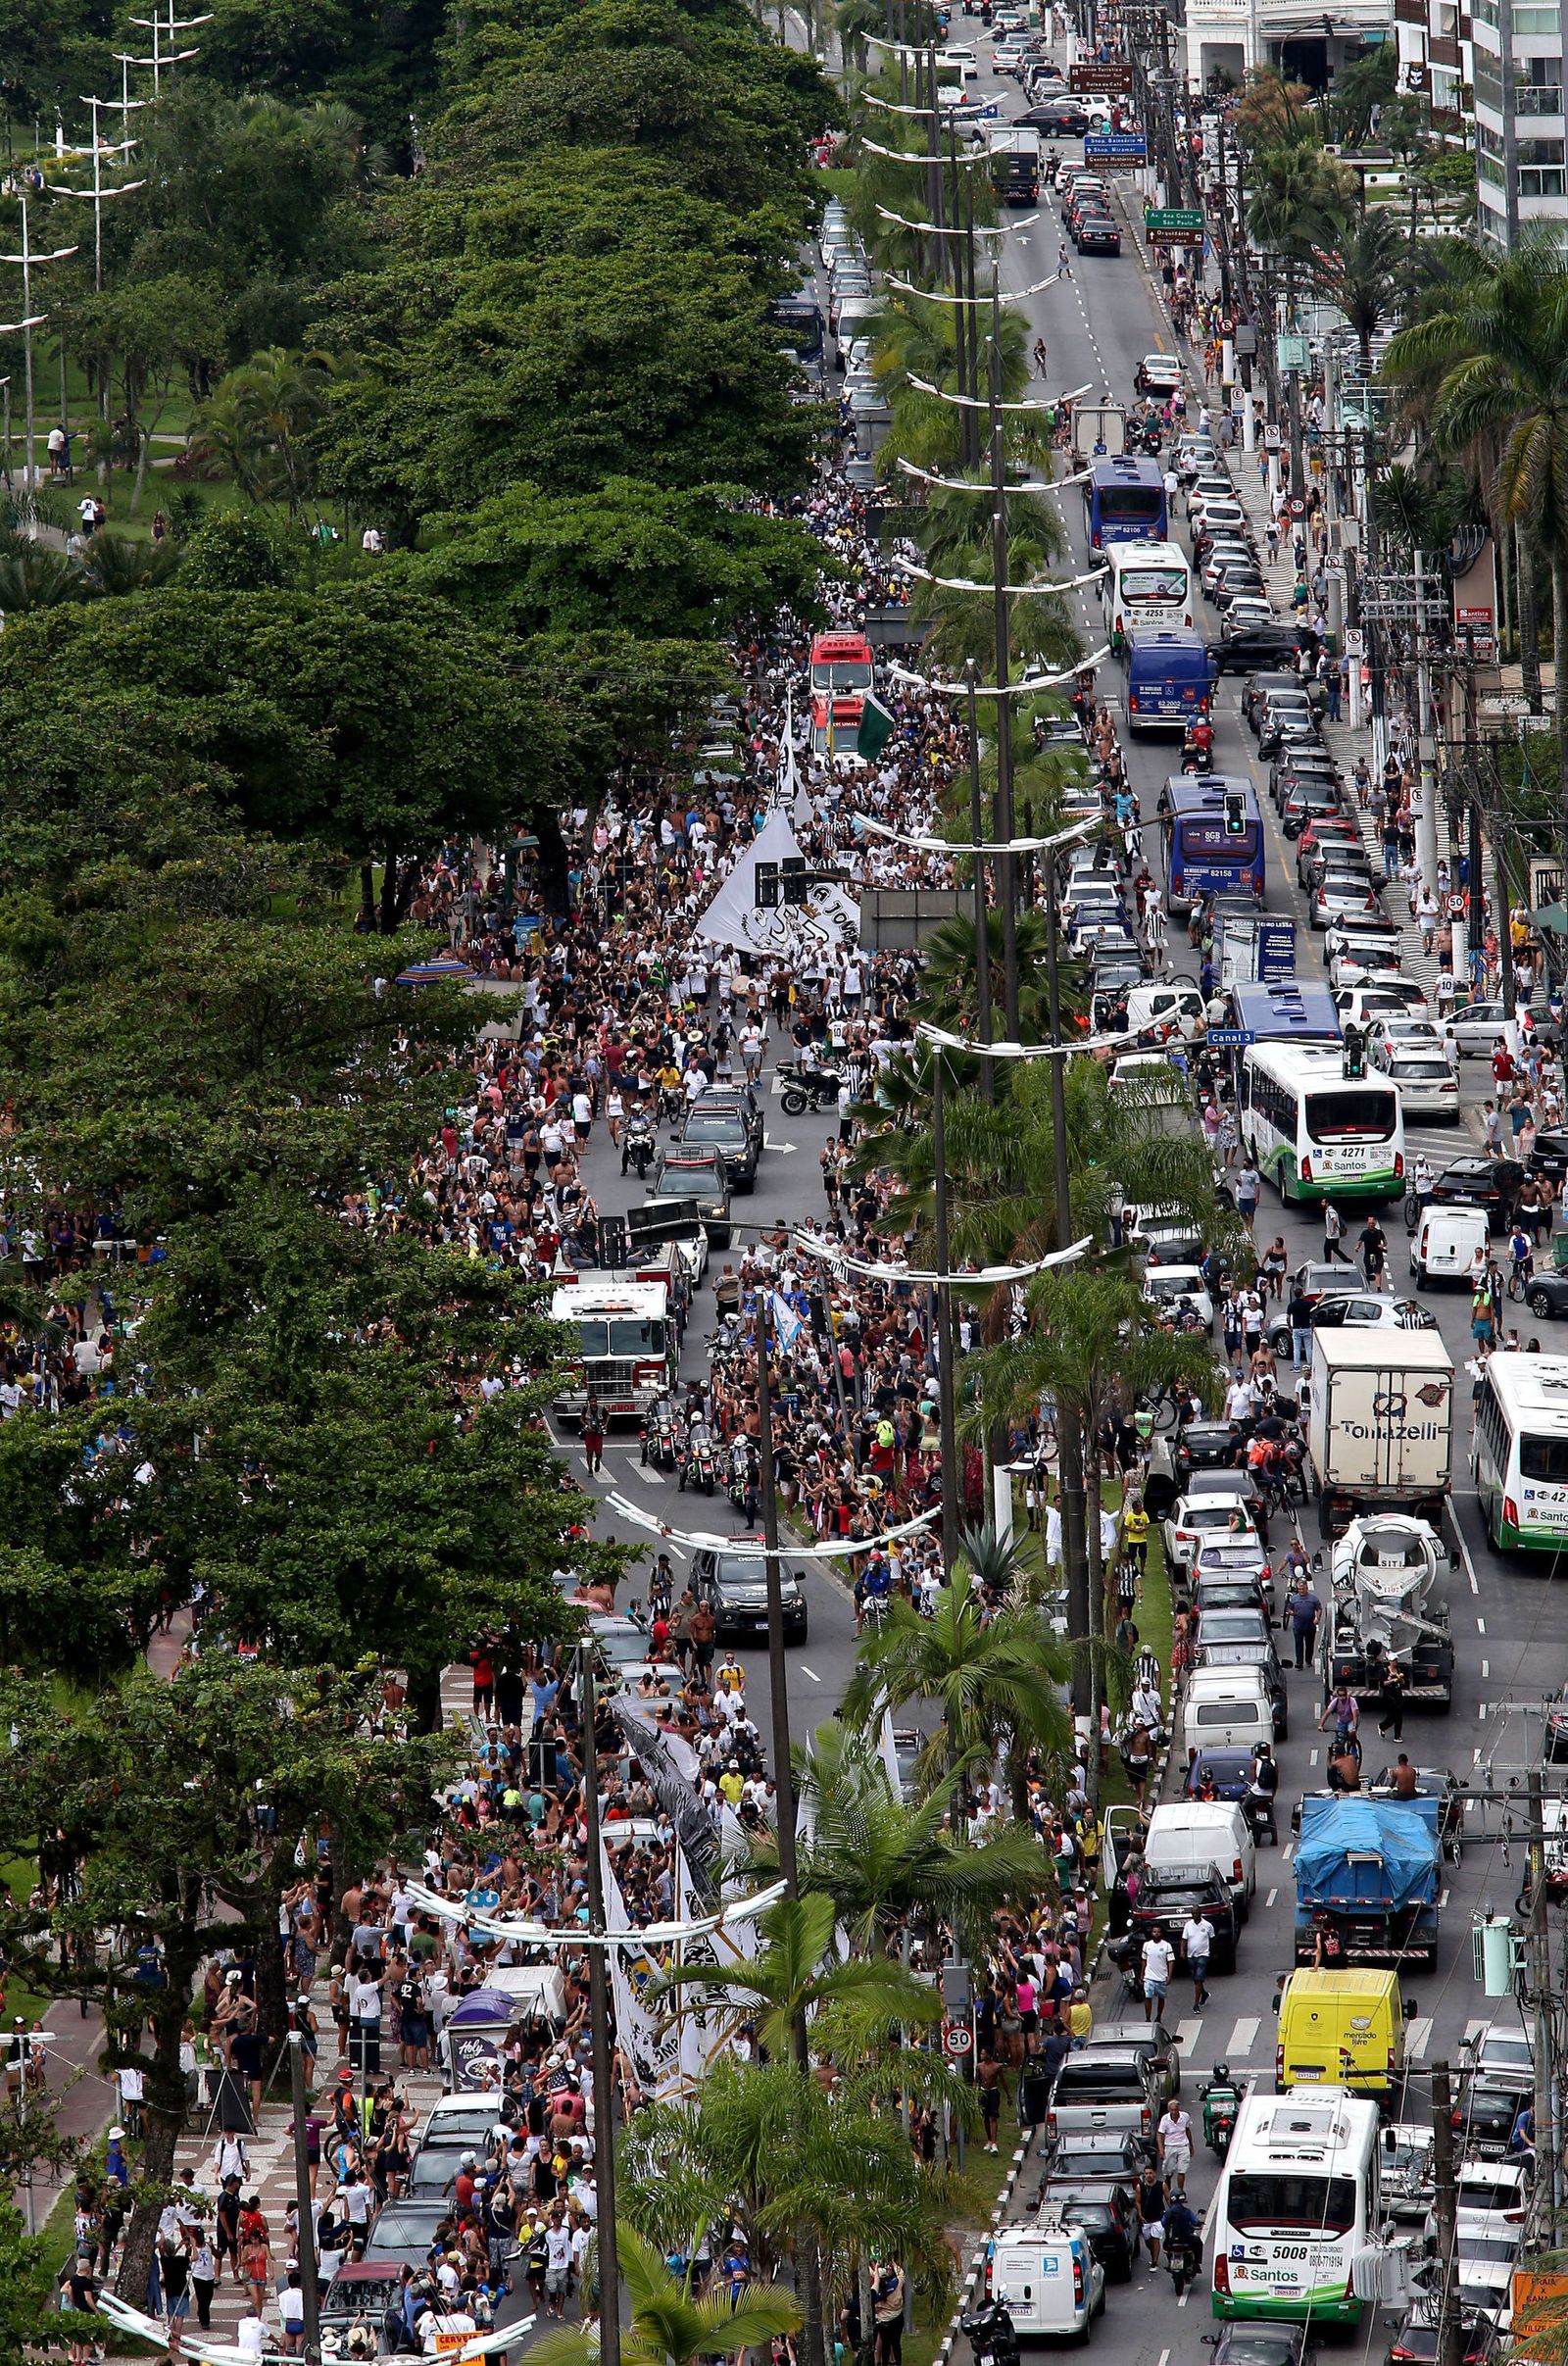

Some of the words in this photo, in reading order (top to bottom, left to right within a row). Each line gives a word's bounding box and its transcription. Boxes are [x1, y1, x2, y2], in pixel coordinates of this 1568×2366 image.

[1450, 898, 1462, 907] 50
[1443, 981, 1451, 990] 10
[1342, 1148, 1365, 1158] 4271
[1334, 1161, 1366, 1170] Santos
[1341, 1420, 1438, 1440] Tomazelli
[1551, 1492, 1568, 1502] 42
[1540, 1511, 1568, 1522] Santo
[950, 2033, 969, 2045] 50
[459, 2039, 484, 2056] Holy
[1272, 2246, 1308, 2260] 5008
[1250, 2269, 1298, 2282] Santos
[440, 2335, 477, 2343] CERVE
